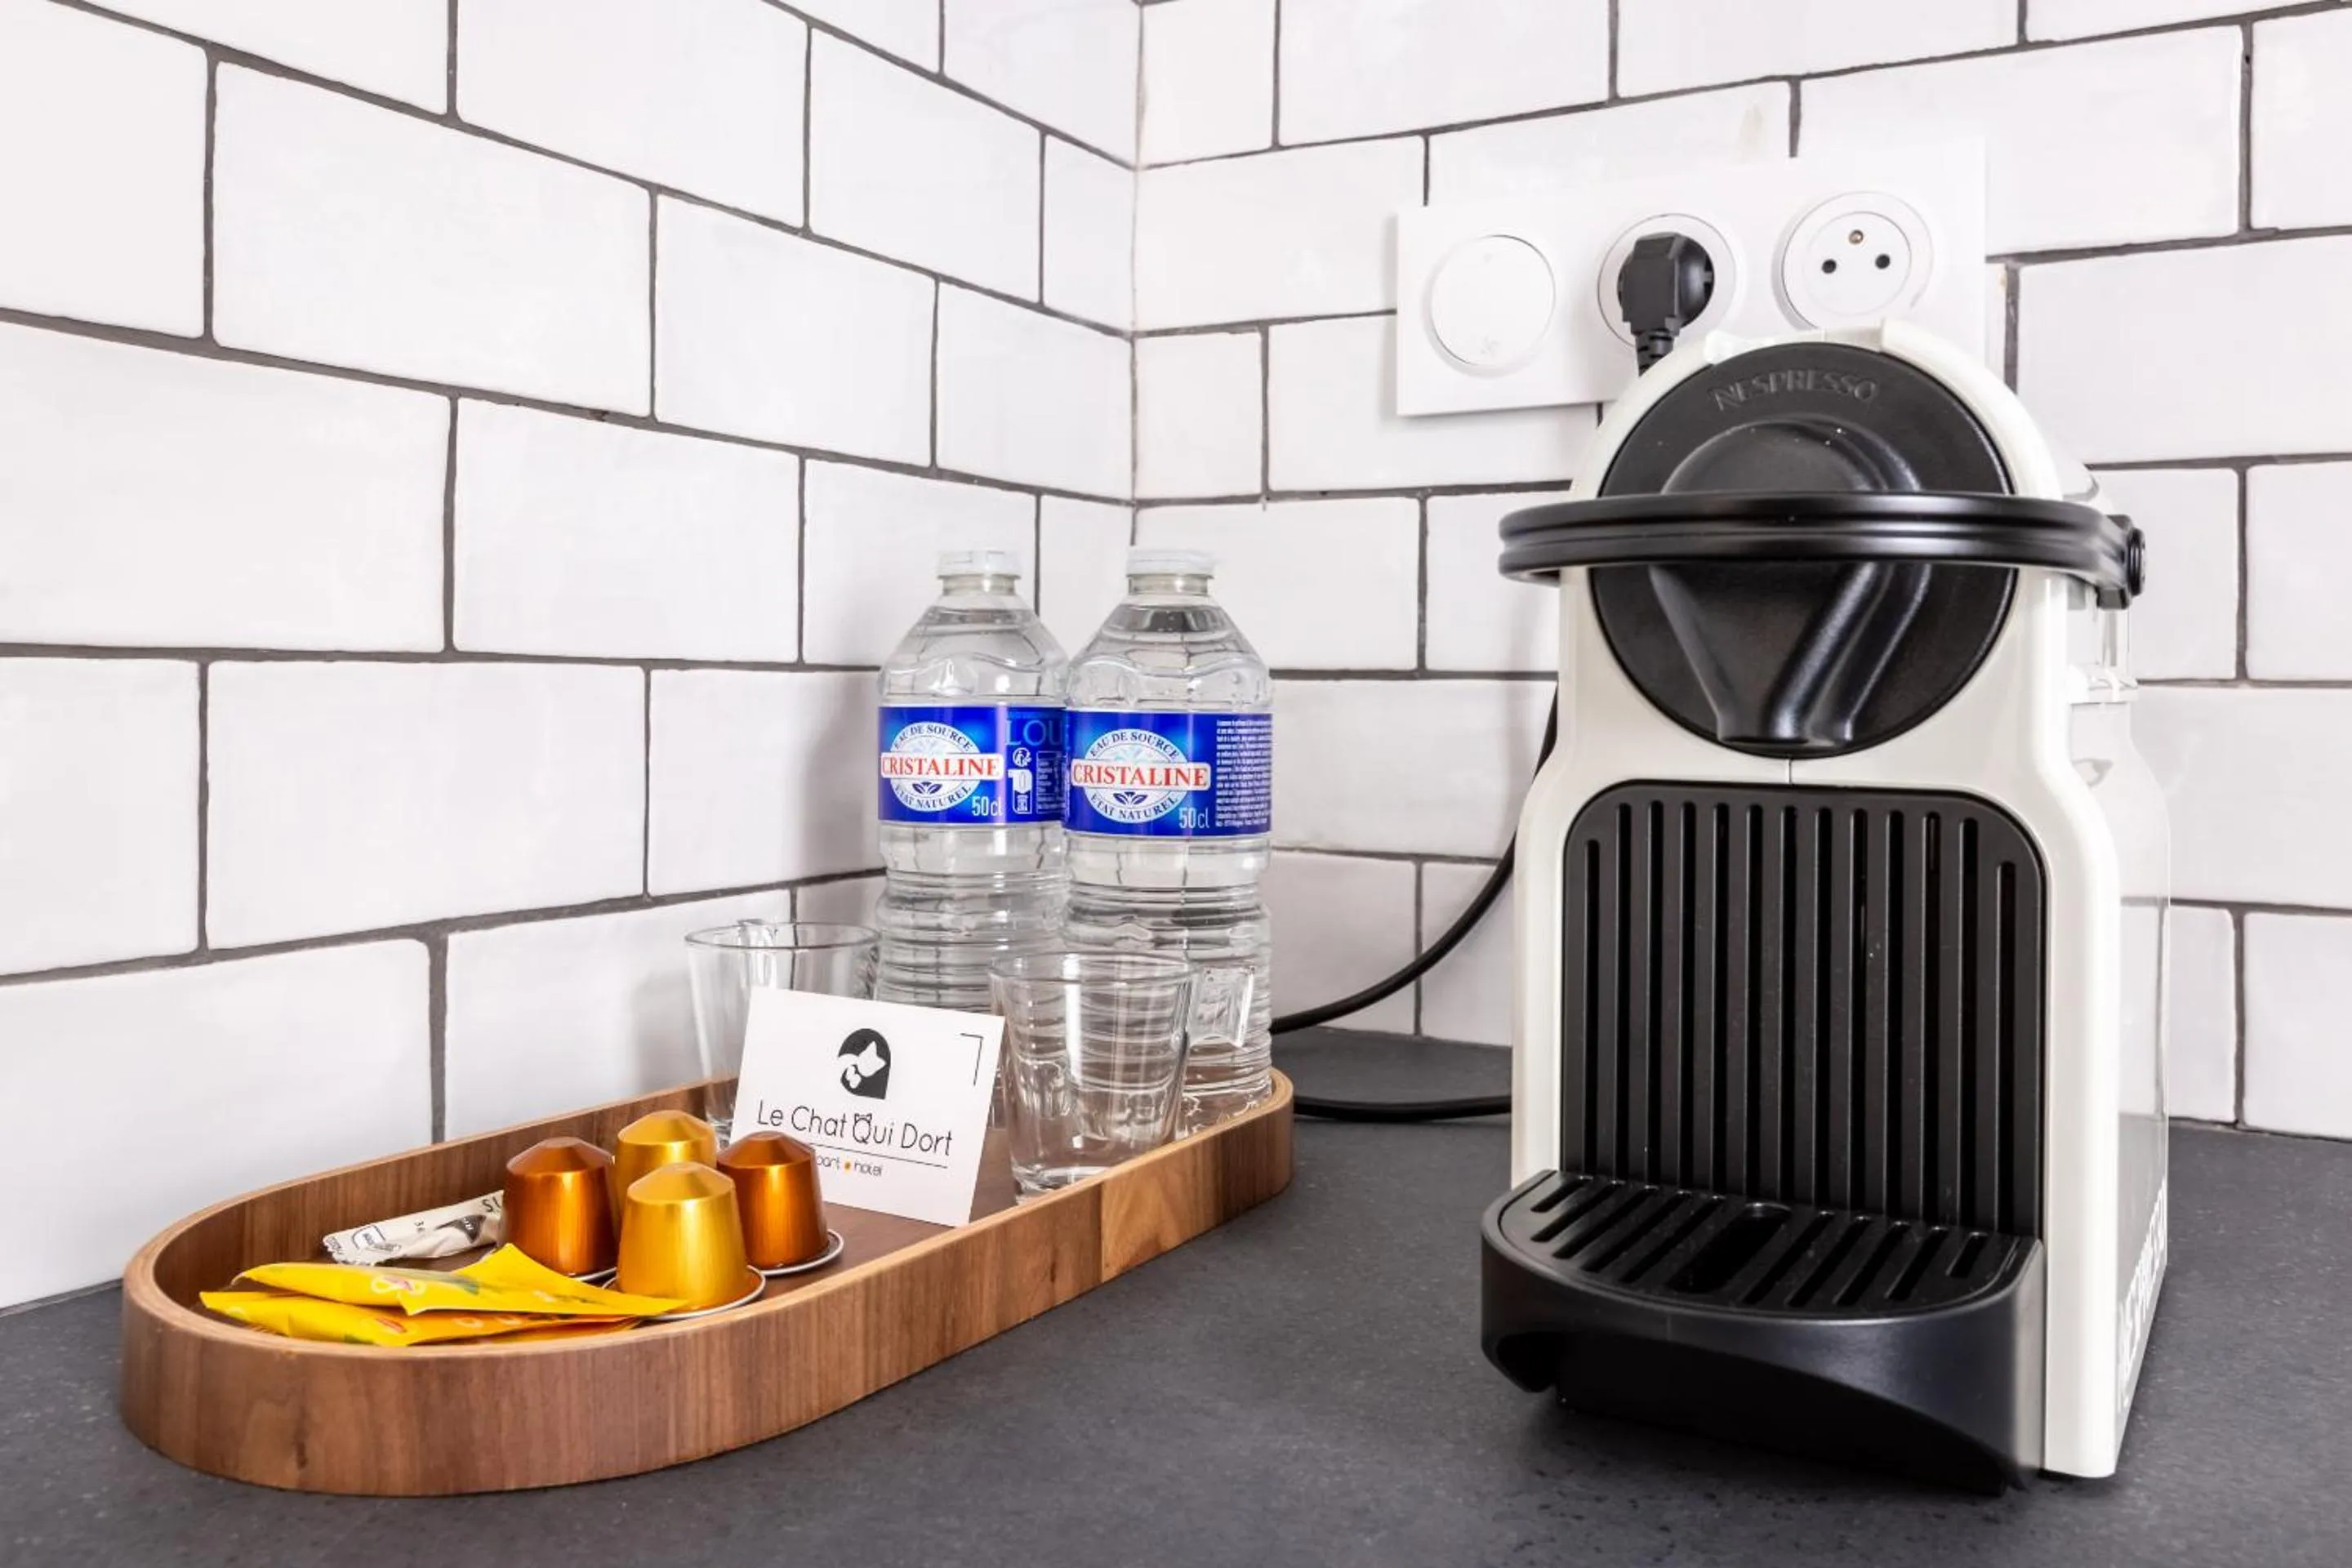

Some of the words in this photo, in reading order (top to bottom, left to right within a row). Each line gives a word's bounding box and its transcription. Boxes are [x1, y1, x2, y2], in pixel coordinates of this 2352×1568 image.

[1707, 369, 1878, 412] NESPRESSO
[911, 724, 925, 734] DE
[926, 724, 973, 752] SOURCE
[1090, 737, 1109, 757] EAU
[1112, 732, 1128, 742] DE
[1130, 733, 1180, 760] SOURCE
[882, 756, 1000, 776] CRISTALINE
[1073, 764, 1208, 786] CRISTALINE
[916, 786, 972, 808] NATUREL
[971, 795, 1004, 817] 50cl
[1120, 795, 1178, 820] NATUREL
[1178, 807, 1210, 829] 50cl
[757, 1099, 783, 1126] Le
[791, 1106, 847, 1138] Chat
[853, 1113, 896, 1146] Qui
[902, 1123, 953, 1156] Dort
